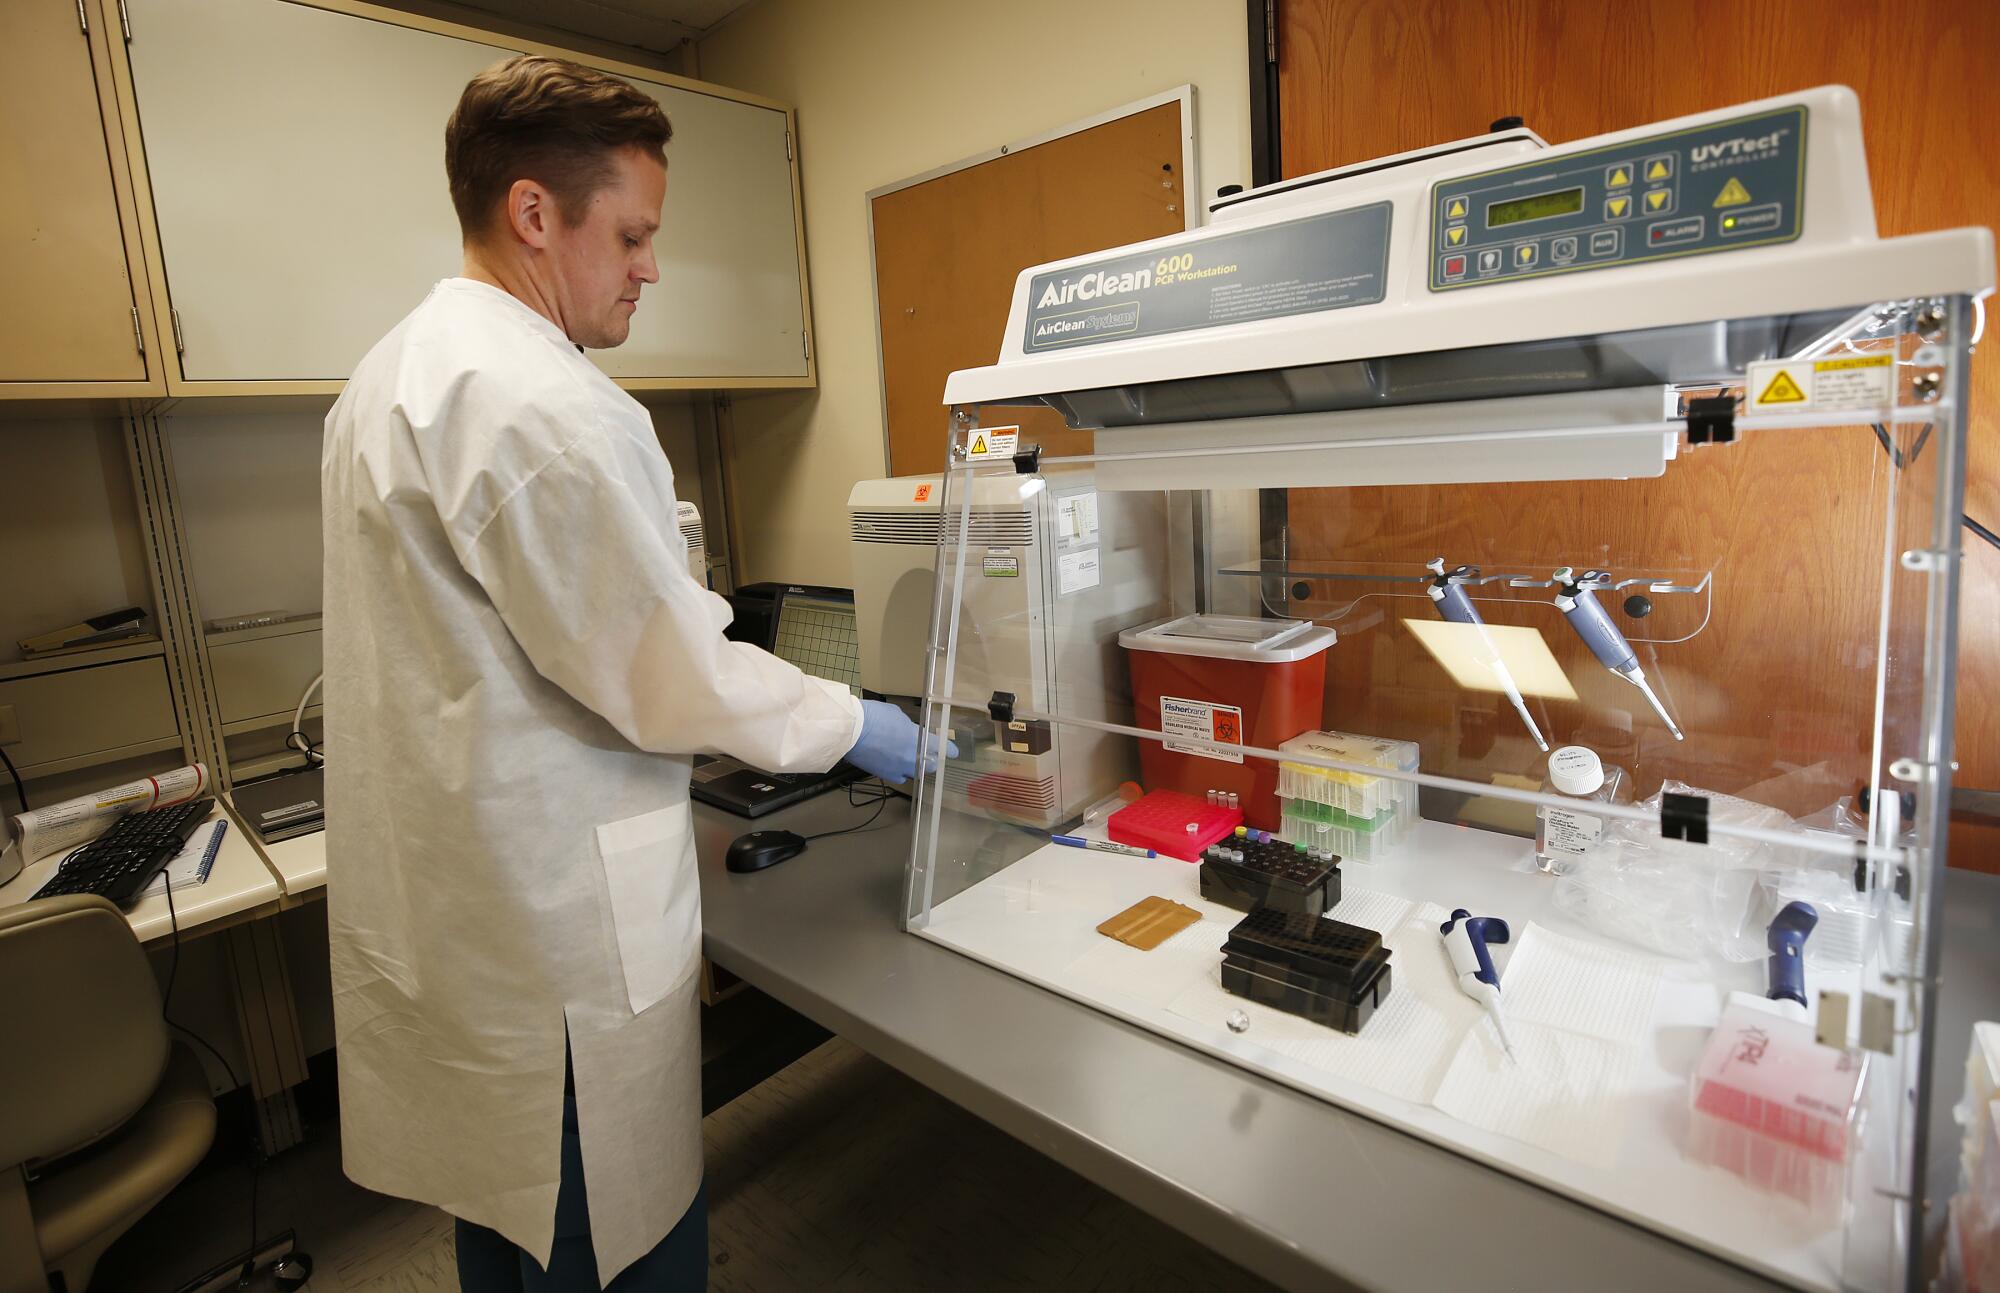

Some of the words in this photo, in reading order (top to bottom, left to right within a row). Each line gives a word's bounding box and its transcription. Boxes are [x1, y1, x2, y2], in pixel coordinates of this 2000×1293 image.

[1665, 224, 1700, 238] ALARM
[1037, 269, 1151, 310] AirClean
[1156, 252, 1193, 276] 600
[1154, 272, 1174, 287] PCR
[1177, 263, 1238, 283] Workstation
[1164, 703, 1207, 716] Fisherbrand
